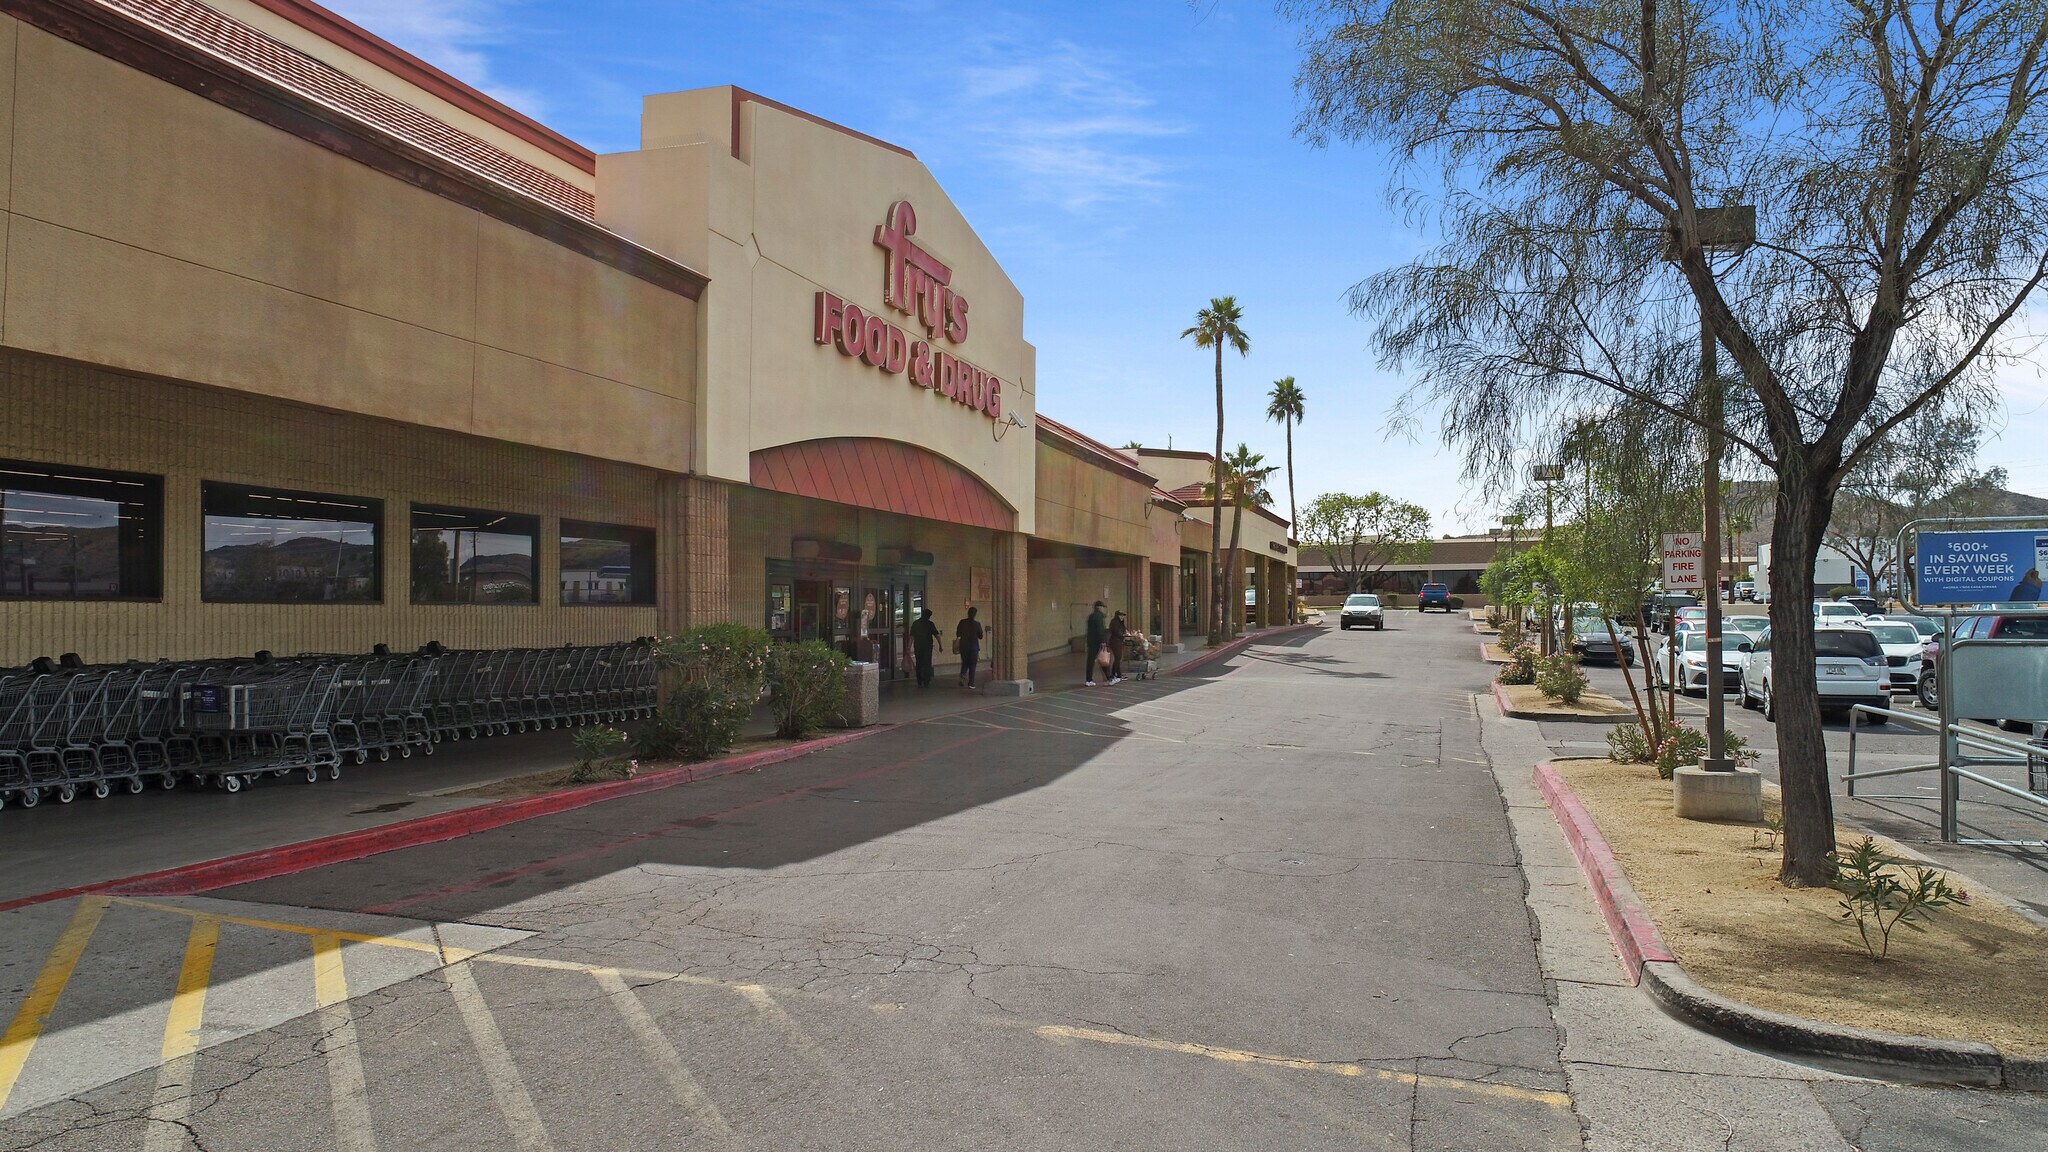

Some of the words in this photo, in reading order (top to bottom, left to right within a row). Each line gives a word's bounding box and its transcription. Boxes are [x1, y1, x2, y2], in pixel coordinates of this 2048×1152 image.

[815, 291, 907, 375] FOOD
[908, 340, 934, 389] &
[934, 351, 1001, 418] DRUG
[1675, 537, 1690, 546] NO
[1947, 542, 1989, 552] $600+
[1664, 549, 1702, 559] PARKING
[1929, 554, 1944, 564] IN
[1948, 553, 2009, 564] SAVINGS
[1672, 562, 1695, 571] FIRE
[1924, 565, 1970, 576] EVERY
[1973, 564, 2015, 575] WEEK
[1670, 574, 1698, 584] LANE
